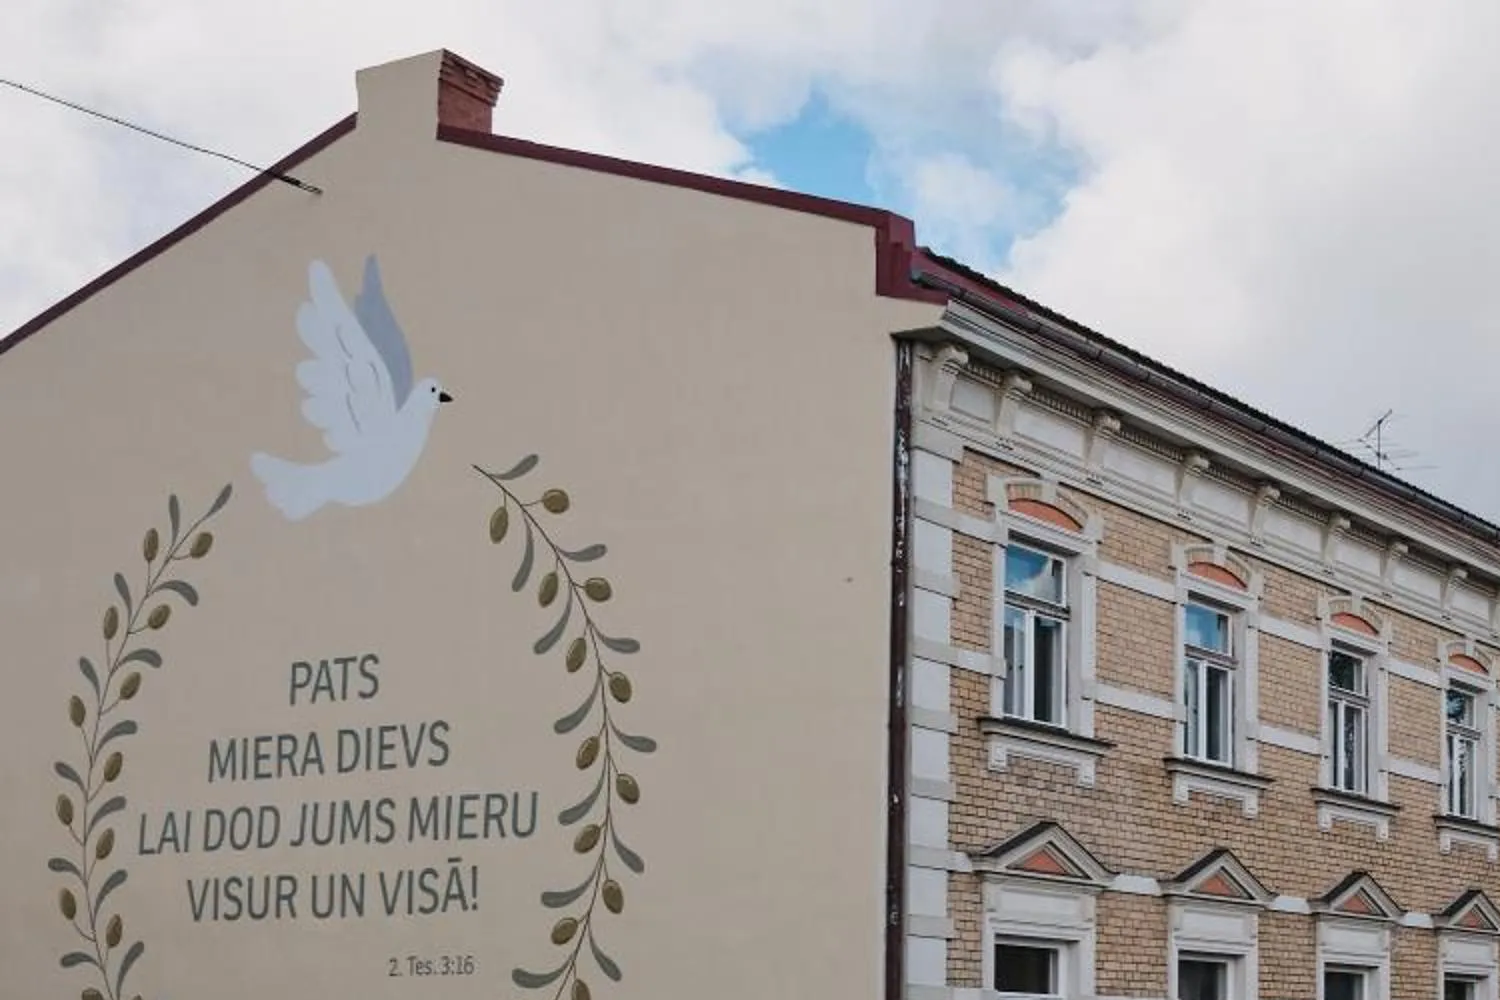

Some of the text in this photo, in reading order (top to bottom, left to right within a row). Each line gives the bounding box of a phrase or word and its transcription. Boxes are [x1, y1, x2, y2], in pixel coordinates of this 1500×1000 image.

[289, 653, 380, 706] PATS
[208, 719, 451, 784] MIERA DIEVS
[138, 791, 540, 857] LAI DOD JUMS MIERU
[186, 856, 479, 923] VISUR UN VISĀ!
[440, 955, 475, 976] 3:16
